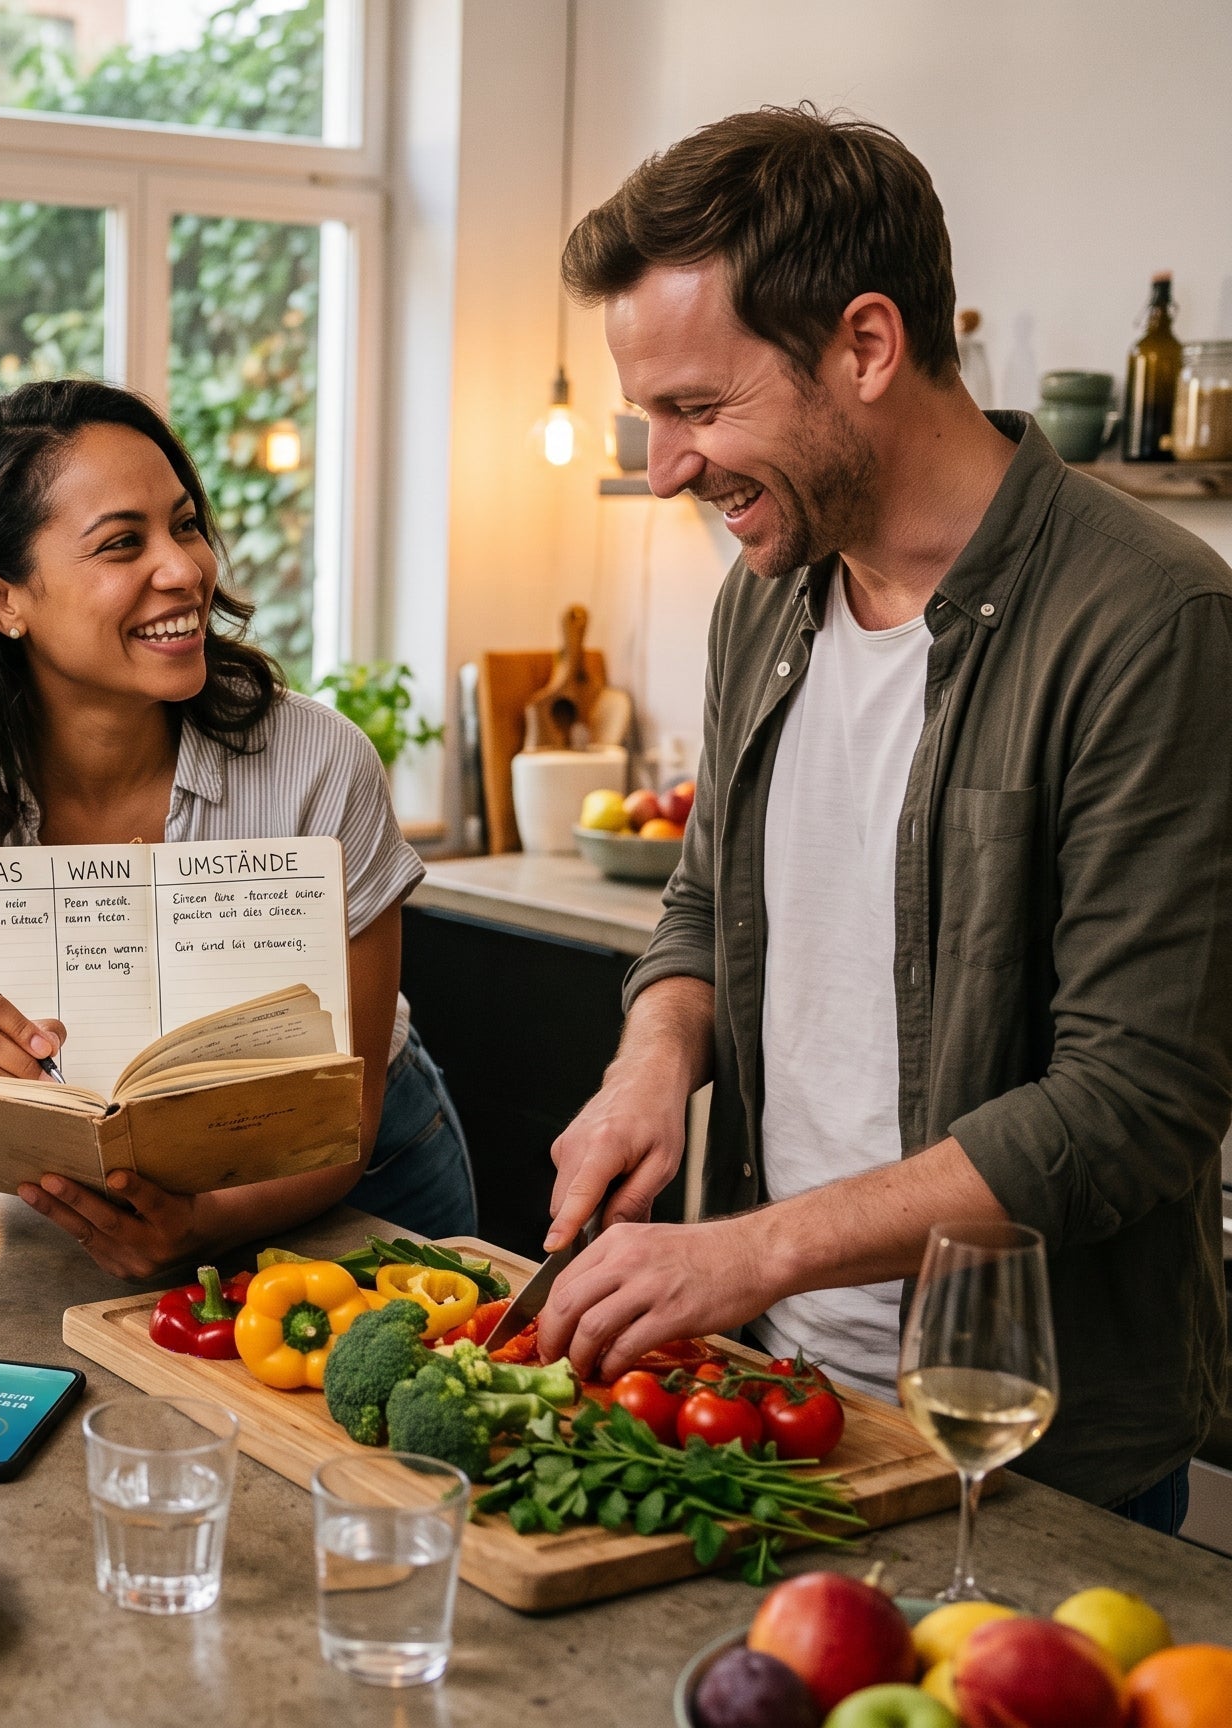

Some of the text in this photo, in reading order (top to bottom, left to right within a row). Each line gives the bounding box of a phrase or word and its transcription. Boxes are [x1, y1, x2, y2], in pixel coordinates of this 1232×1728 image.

[68, 860, 130, 880] WANN
[179, 851, 298, 876] UMSTÄNDE
[0, 917, 6, 925] in
